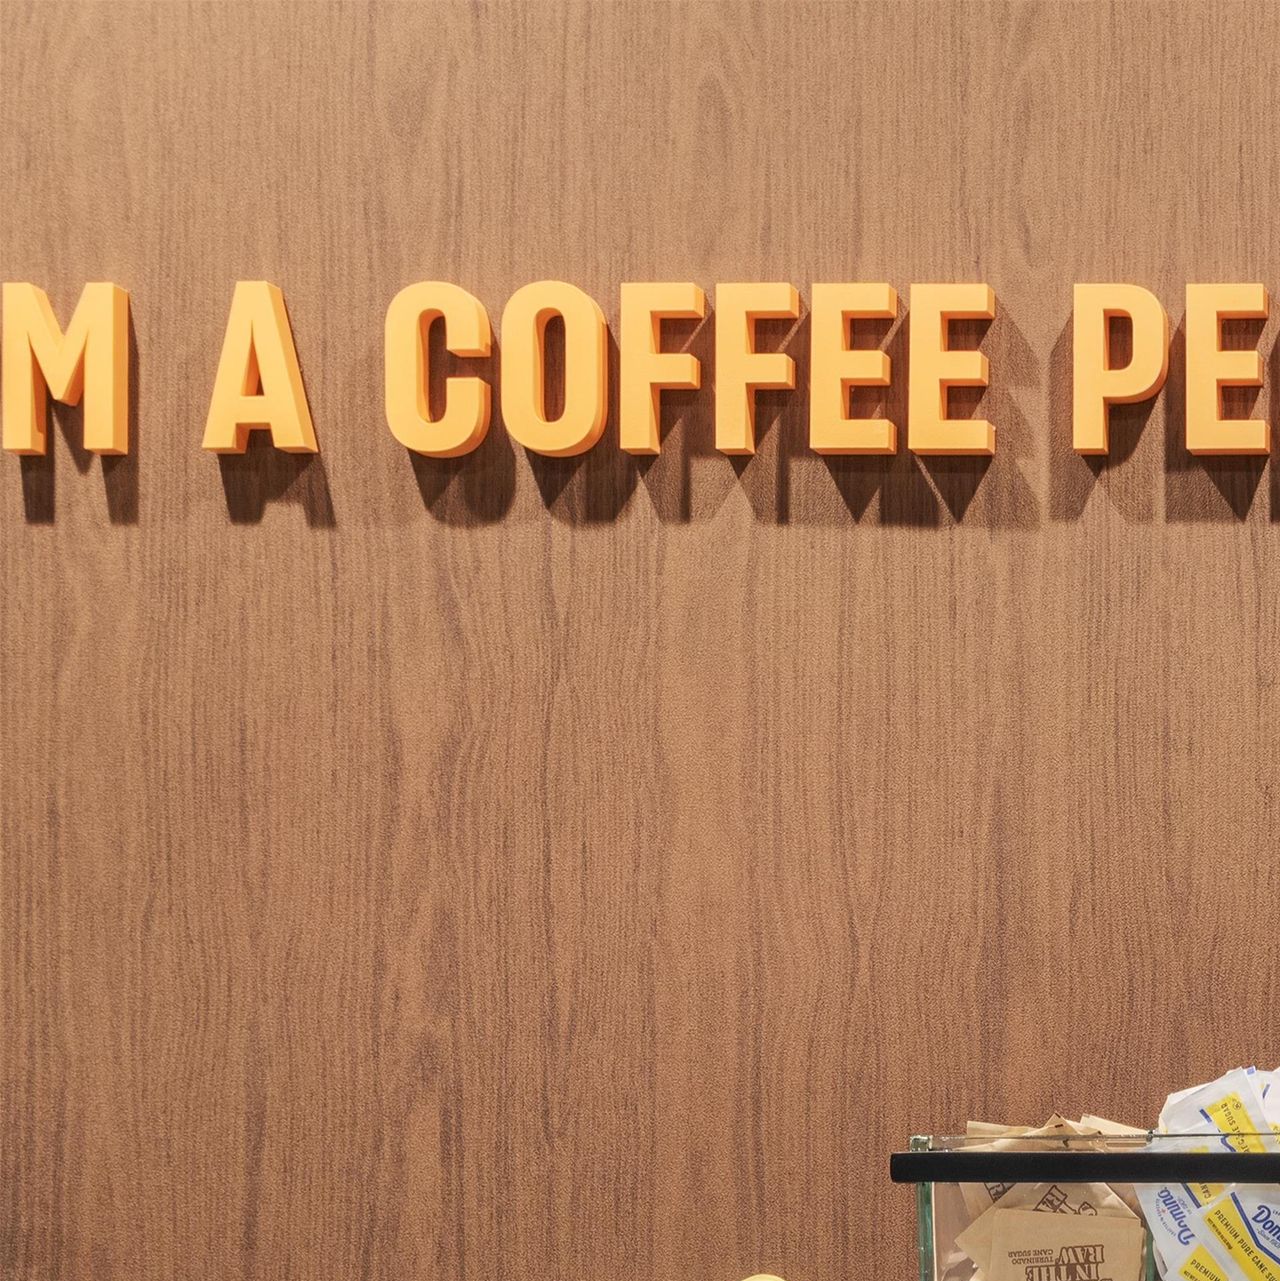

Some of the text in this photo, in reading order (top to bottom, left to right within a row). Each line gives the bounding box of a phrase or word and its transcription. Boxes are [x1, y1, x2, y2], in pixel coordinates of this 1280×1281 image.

[2, 281, 129, 456] M
[201, 280, 319, 455] A
[384, 280, 996, 458] COFFEE
[1214, 1208, 1239, 1240] PREMIUM
[1237, 1237, 1254, 1258] PURE
[1250, 1253, 1269, 1274] CANE
[1036, 1248, 1054, 1257] CANE
[1054, 1243, 1105, 1264] RAW
[1074, 1262, 1100, 1281] IN
